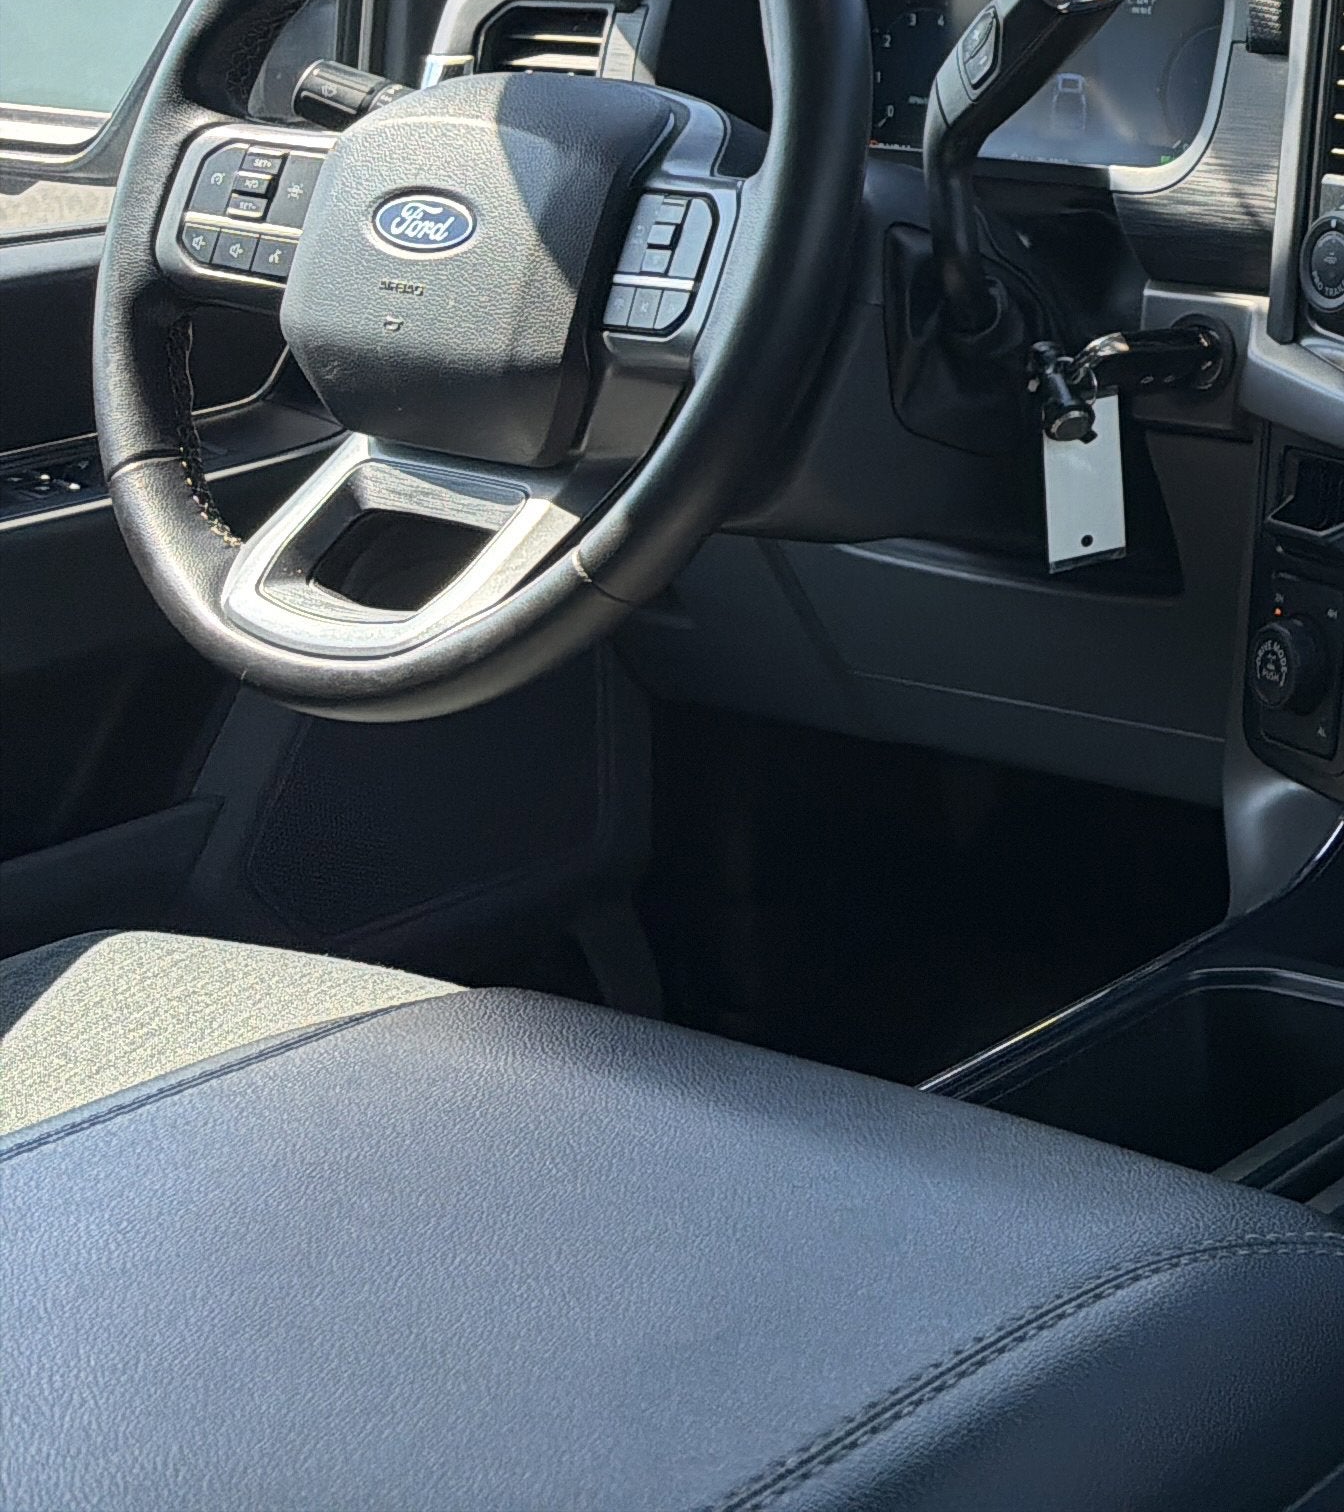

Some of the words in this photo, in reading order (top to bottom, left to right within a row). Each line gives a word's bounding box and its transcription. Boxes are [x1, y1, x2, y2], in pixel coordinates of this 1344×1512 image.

[390, 202, 455, 241] Ford
[1256, 640, 1272, 666] DRIVE
[1274, 641, 1288, 674] MODE
